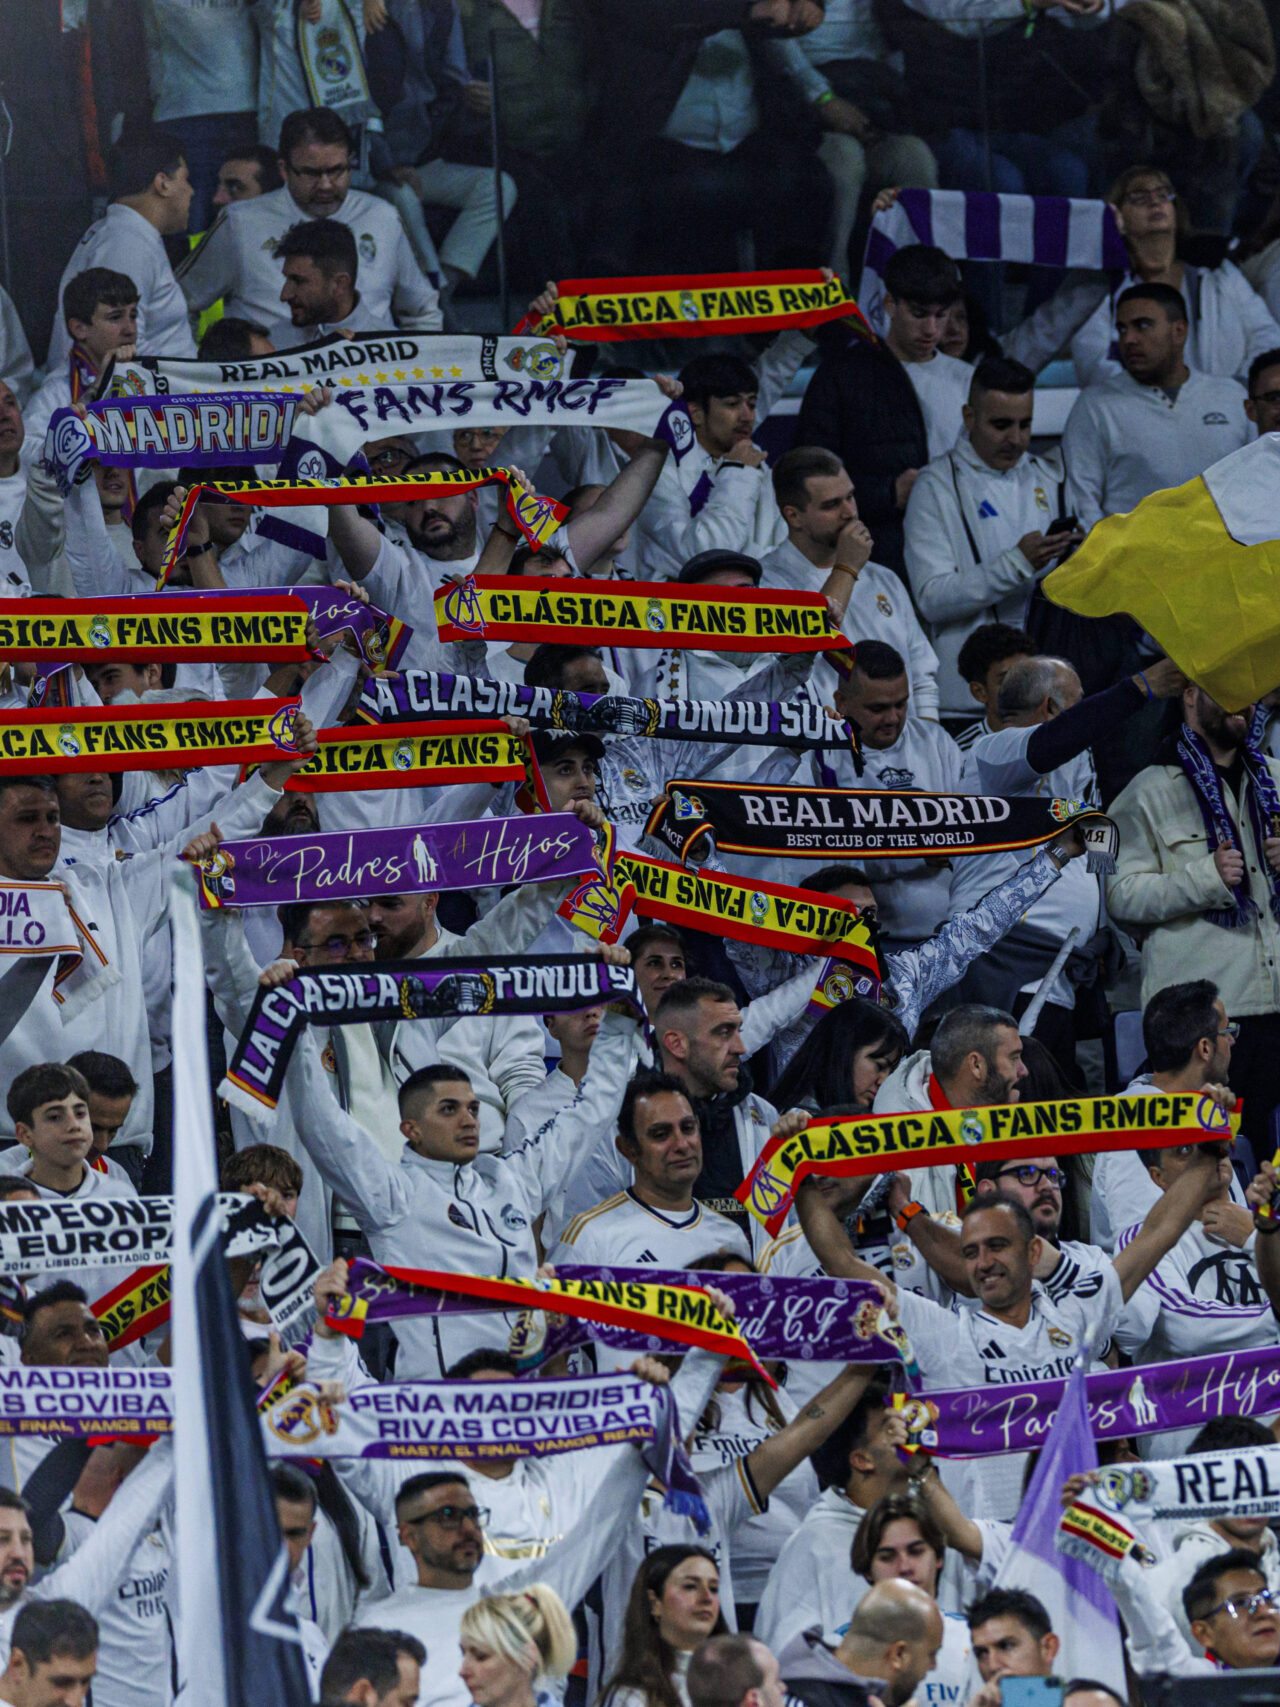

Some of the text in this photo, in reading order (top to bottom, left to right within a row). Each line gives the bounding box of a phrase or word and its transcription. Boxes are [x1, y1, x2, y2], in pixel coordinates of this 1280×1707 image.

[702, 287, 777, 318] FANS
[219, 341, 419, 383] REAL MADRID
[483, 338, 496, 376] RMCF
[170, 394, 239, 404] ORGULLOSO
[241, 394, 257, 402] DE
[315, 378, 337, 389] 14
[335, 380, 627, 432] FANS RMCF
[92, 400, 297, 456] MADRIDI
[490, 588, 642, 630] CLÁSICA
[671, 604, 747, 634] FANS
[117, 616, 201, 645] FANS
[211, 614, 304, 644] RMCF
[405, 670, 554, 719] CLASICA
[660, 699, 770, 736] FONDO
[781, 701, 846, 740] SUR
[0, 718, 265, 758] CA FANS RMCF
[419, 736, 501, 768] FANS
[740, 795, 1012, 829] REAL MADRID
[786, 831, 975, 848] BEST CLUB OF THE WORLD
[267, 836, 410, 899] Padres
[465, 821, 580, 881] Hijos
[676, 875, 747, 918] FANS
[239, 1030, 282, 1086] LA
[494, 963, 600, 999] FONDO
[781, 1095, 1194, 1172] CLÁSICA FANS RMCF
[0, 1198, 174, 1235] MPEONE
[4, 1251, 170, 1272] 2014 LISBOA ESTADIO DA
[985, 1356, 1074, 1384] Emirate
[351, 1381, 665, 1413] PEÑA MADRIDISTA
[79, 1420, 140, 1433] VAMOS
[379, 1404, 652, 1439] RIVAS COVIBAR
[455, 1444, 475, 1456] EL
[533, 1434, 598, 1453] VAMOS
[1174, 1457, 1280, 1504] REAL
